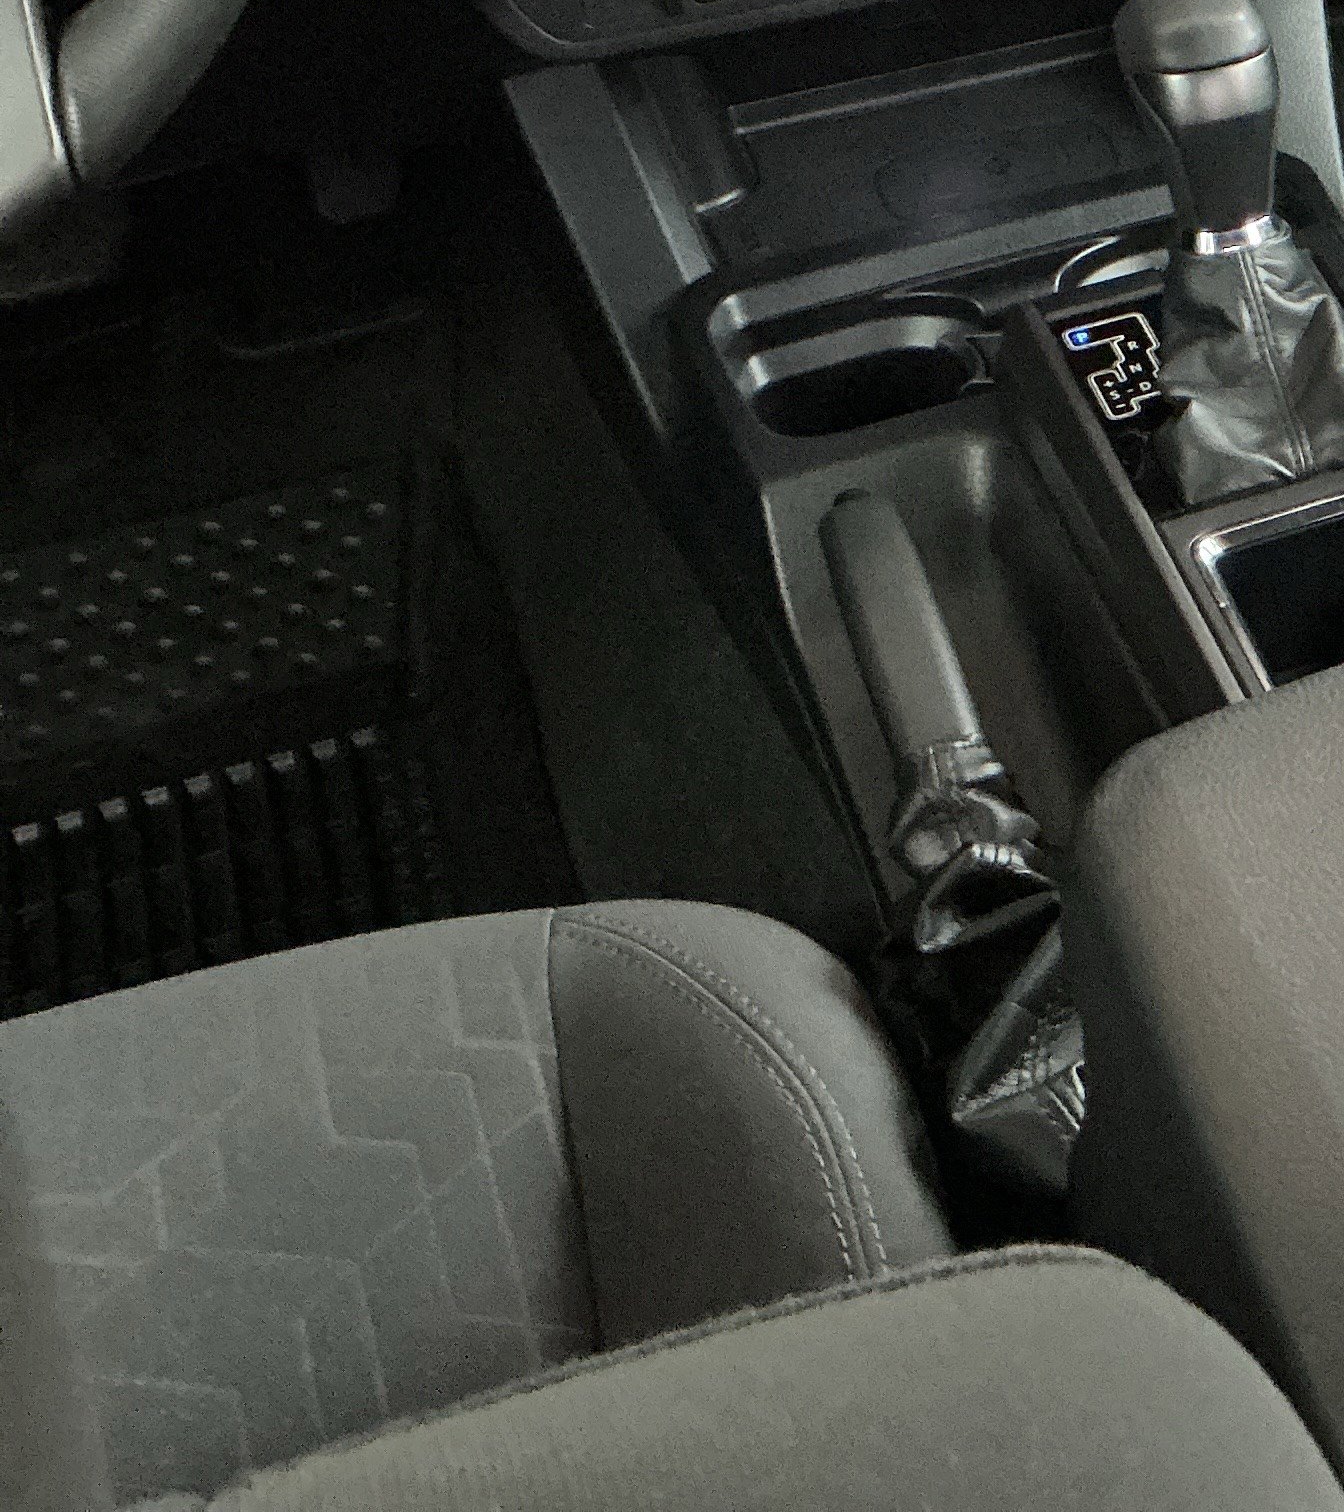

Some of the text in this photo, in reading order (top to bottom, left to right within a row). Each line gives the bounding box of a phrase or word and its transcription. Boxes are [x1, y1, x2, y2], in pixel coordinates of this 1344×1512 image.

[1127, 340, 1139, 351] R
[1129, 362, 1143, 373] N
[1109, 381, 1152, 400] S D
